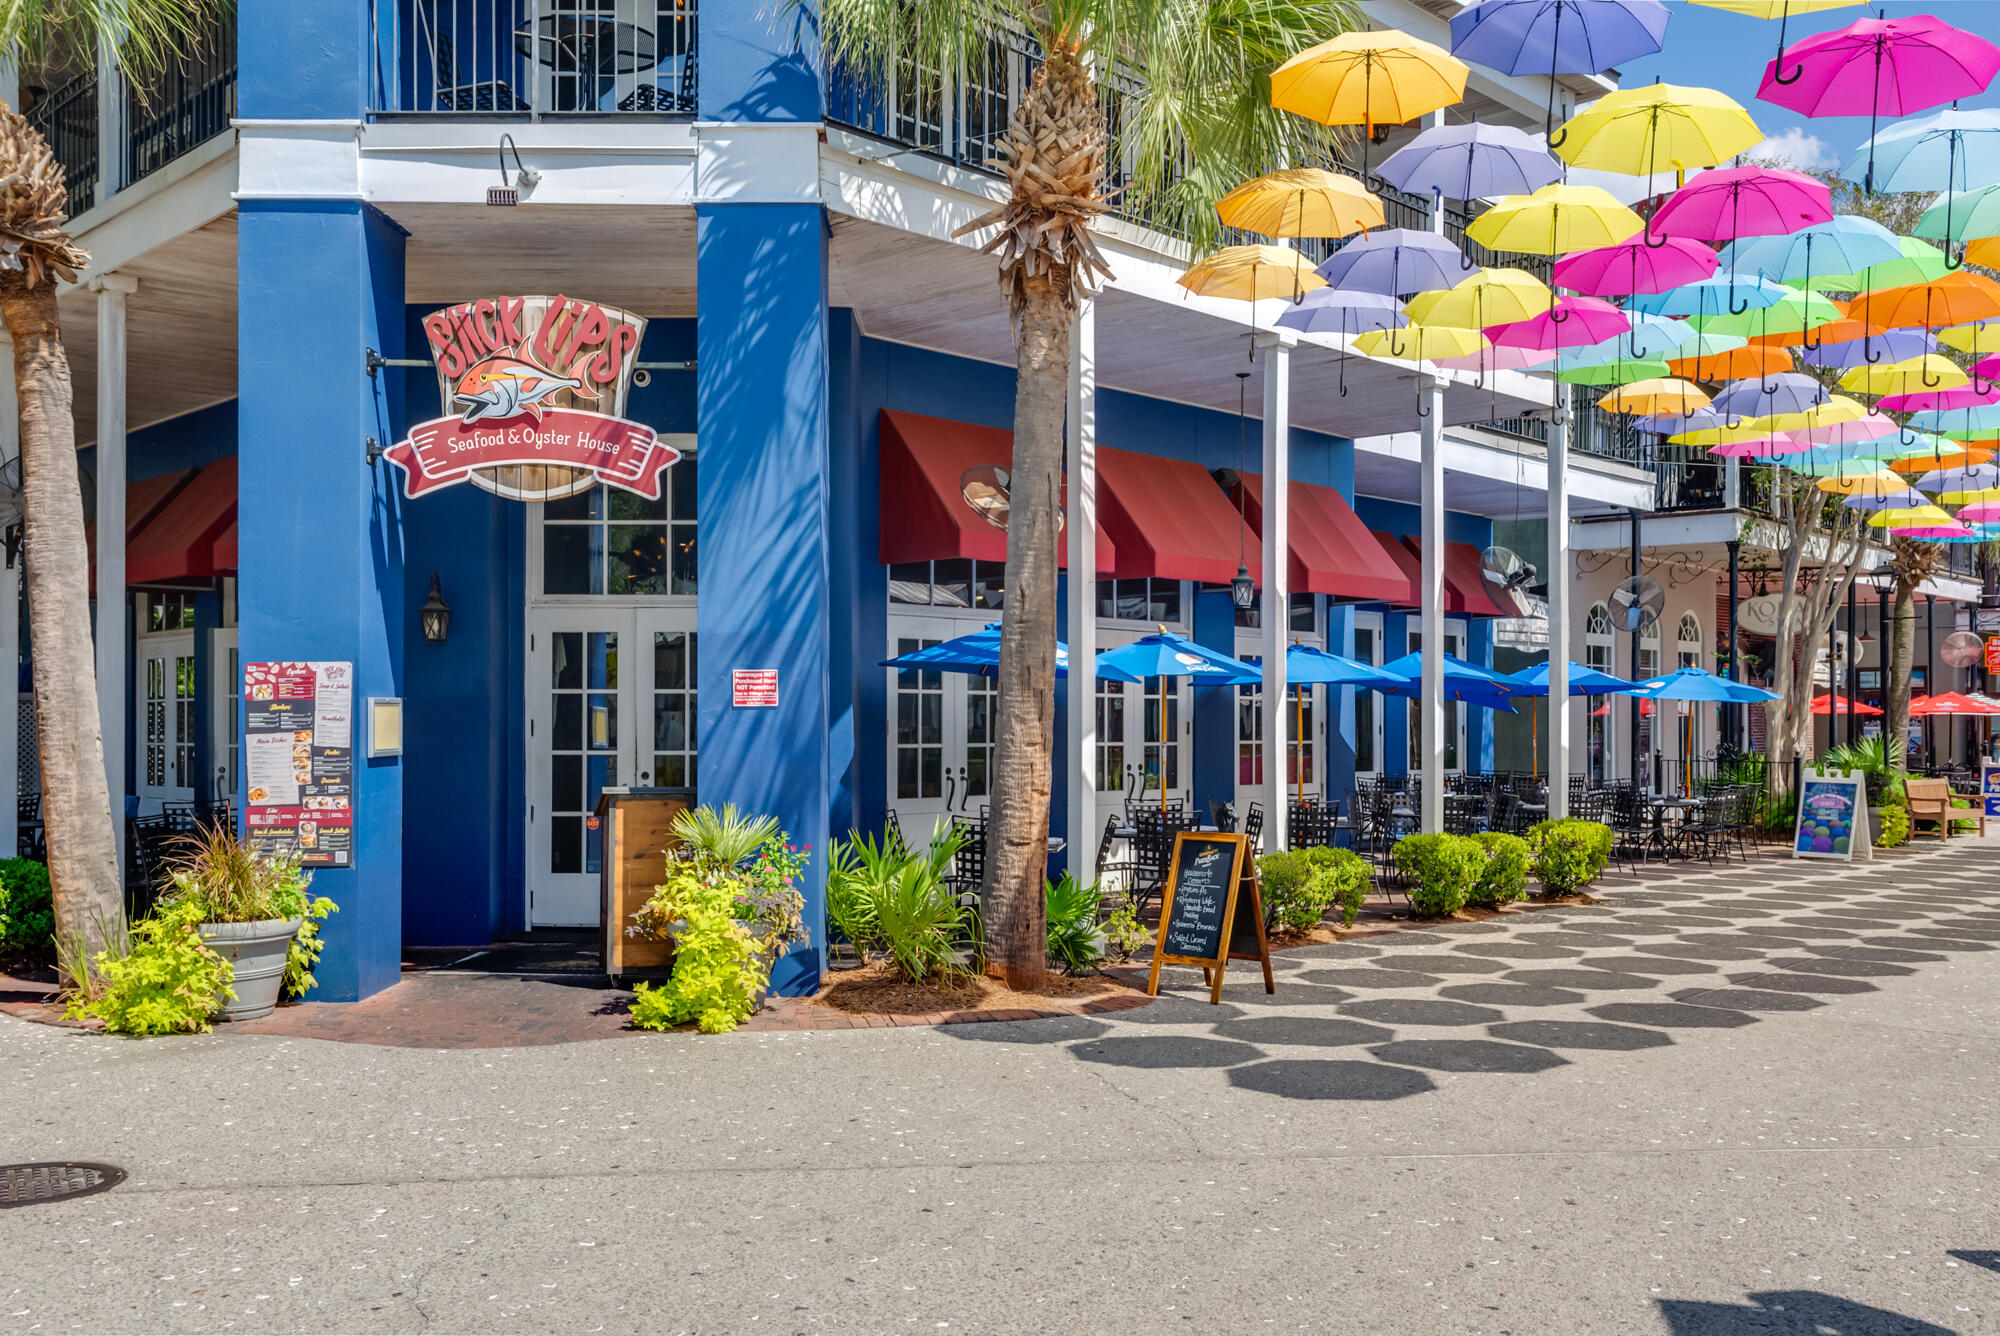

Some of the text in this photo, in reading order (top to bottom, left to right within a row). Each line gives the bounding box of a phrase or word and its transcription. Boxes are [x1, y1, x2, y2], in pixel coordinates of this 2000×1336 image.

[447, 425, 620, 455] Seafood & Oyster House
[1747, 601, 1804, 622] KOA
